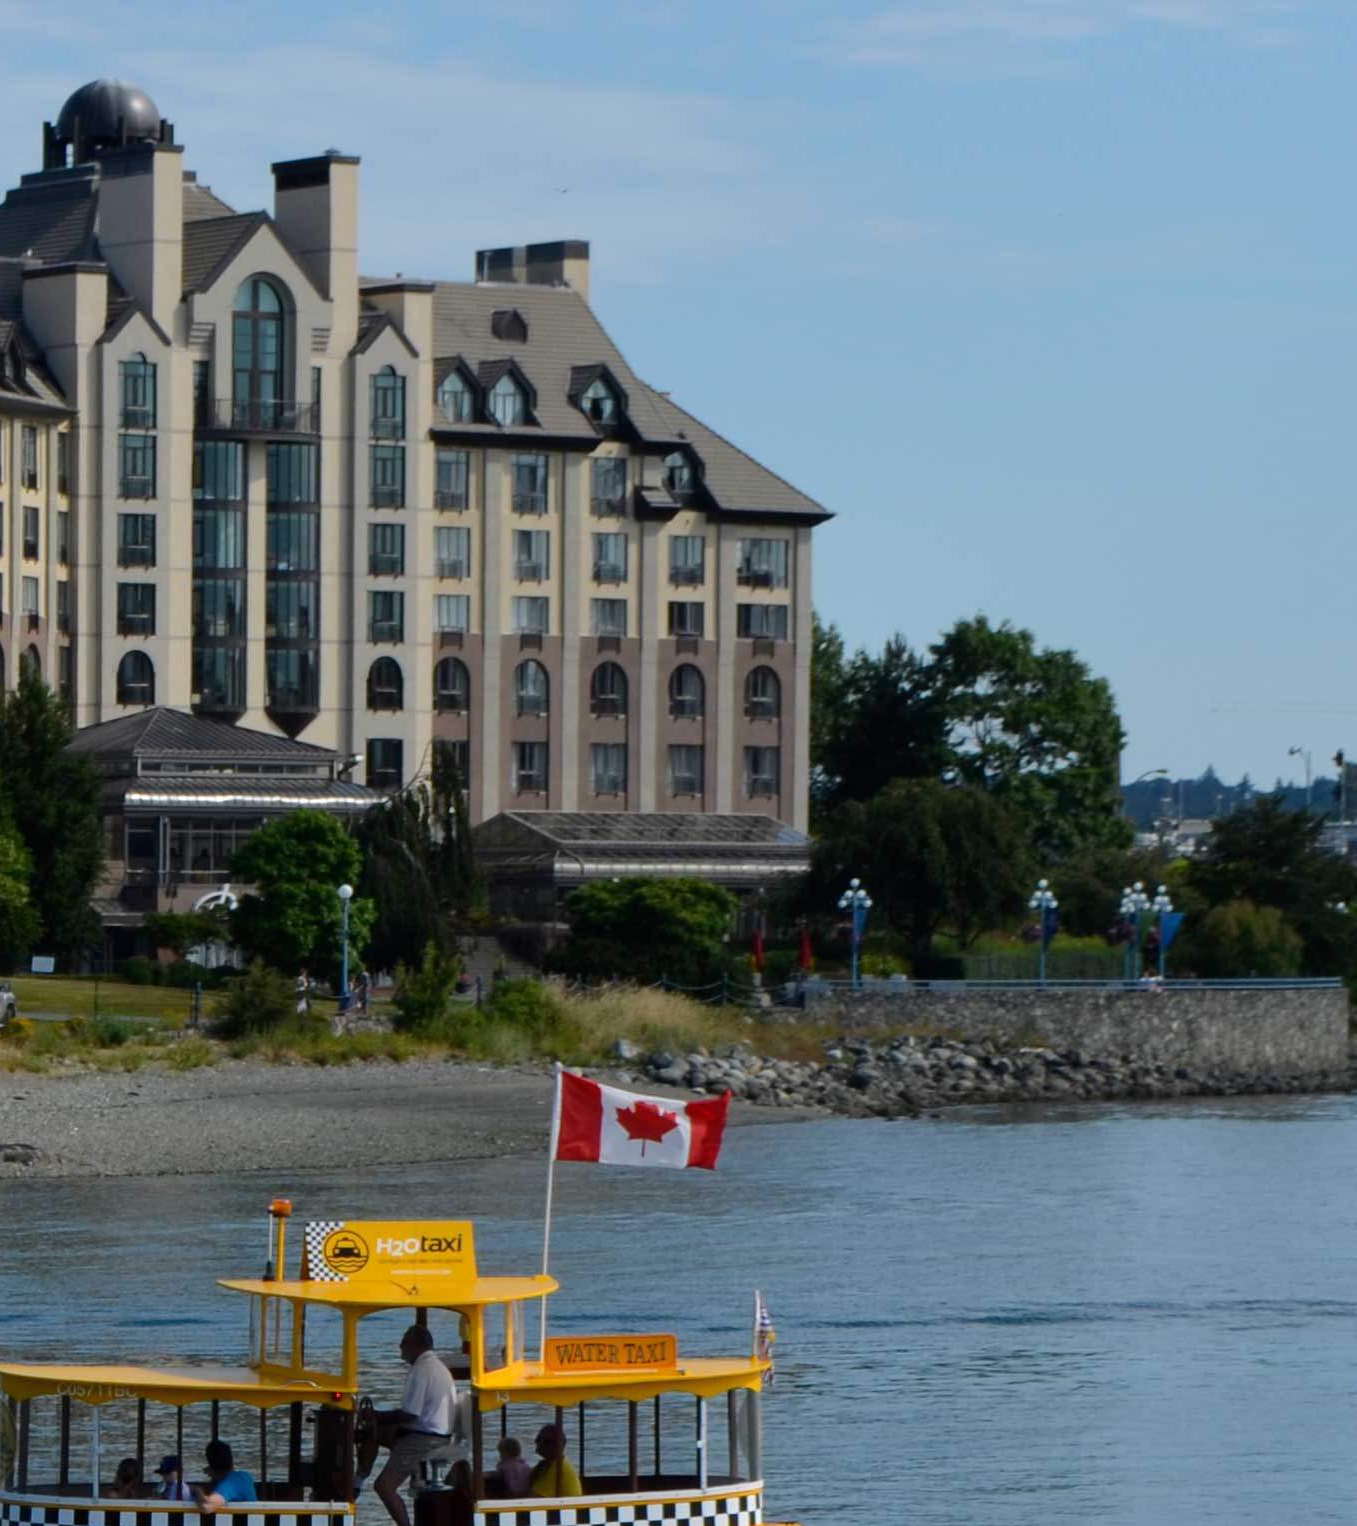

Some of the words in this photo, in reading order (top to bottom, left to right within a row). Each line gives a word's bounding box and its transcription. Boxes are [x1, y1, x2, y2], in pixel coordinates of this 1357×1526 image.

[376, 1234, 462, 1257] H2Otaxi
[556, 1343, 620, 1364] WATER
[623, 1341, 667, 1363] TAXI
